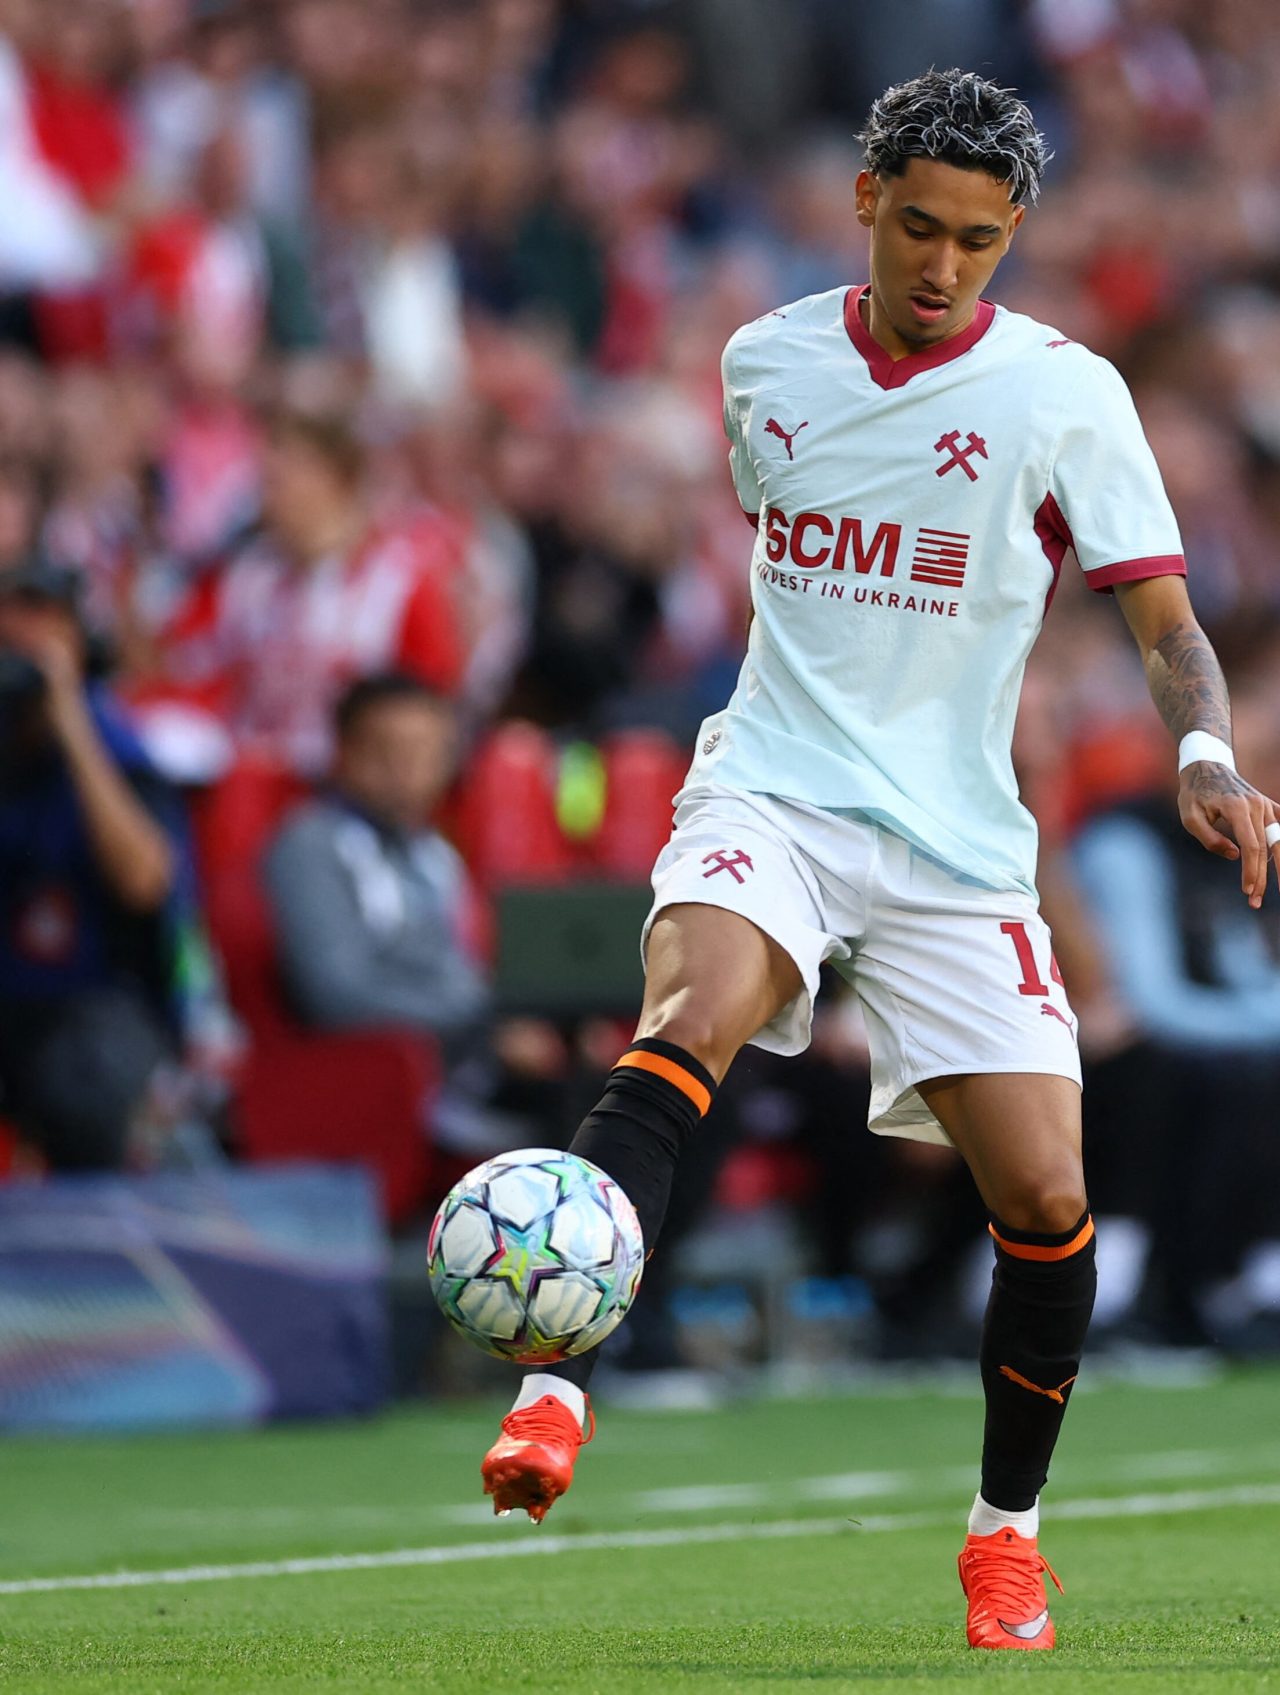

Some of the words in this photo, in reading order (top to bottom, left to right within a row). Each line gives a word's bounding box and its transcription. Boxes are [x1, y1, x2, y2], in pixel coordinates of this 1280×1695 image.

[766, 507, 902, 577] SCM
[821, 582, 846, 600] IN
[854, 587, 960, 617] UKRAINE
